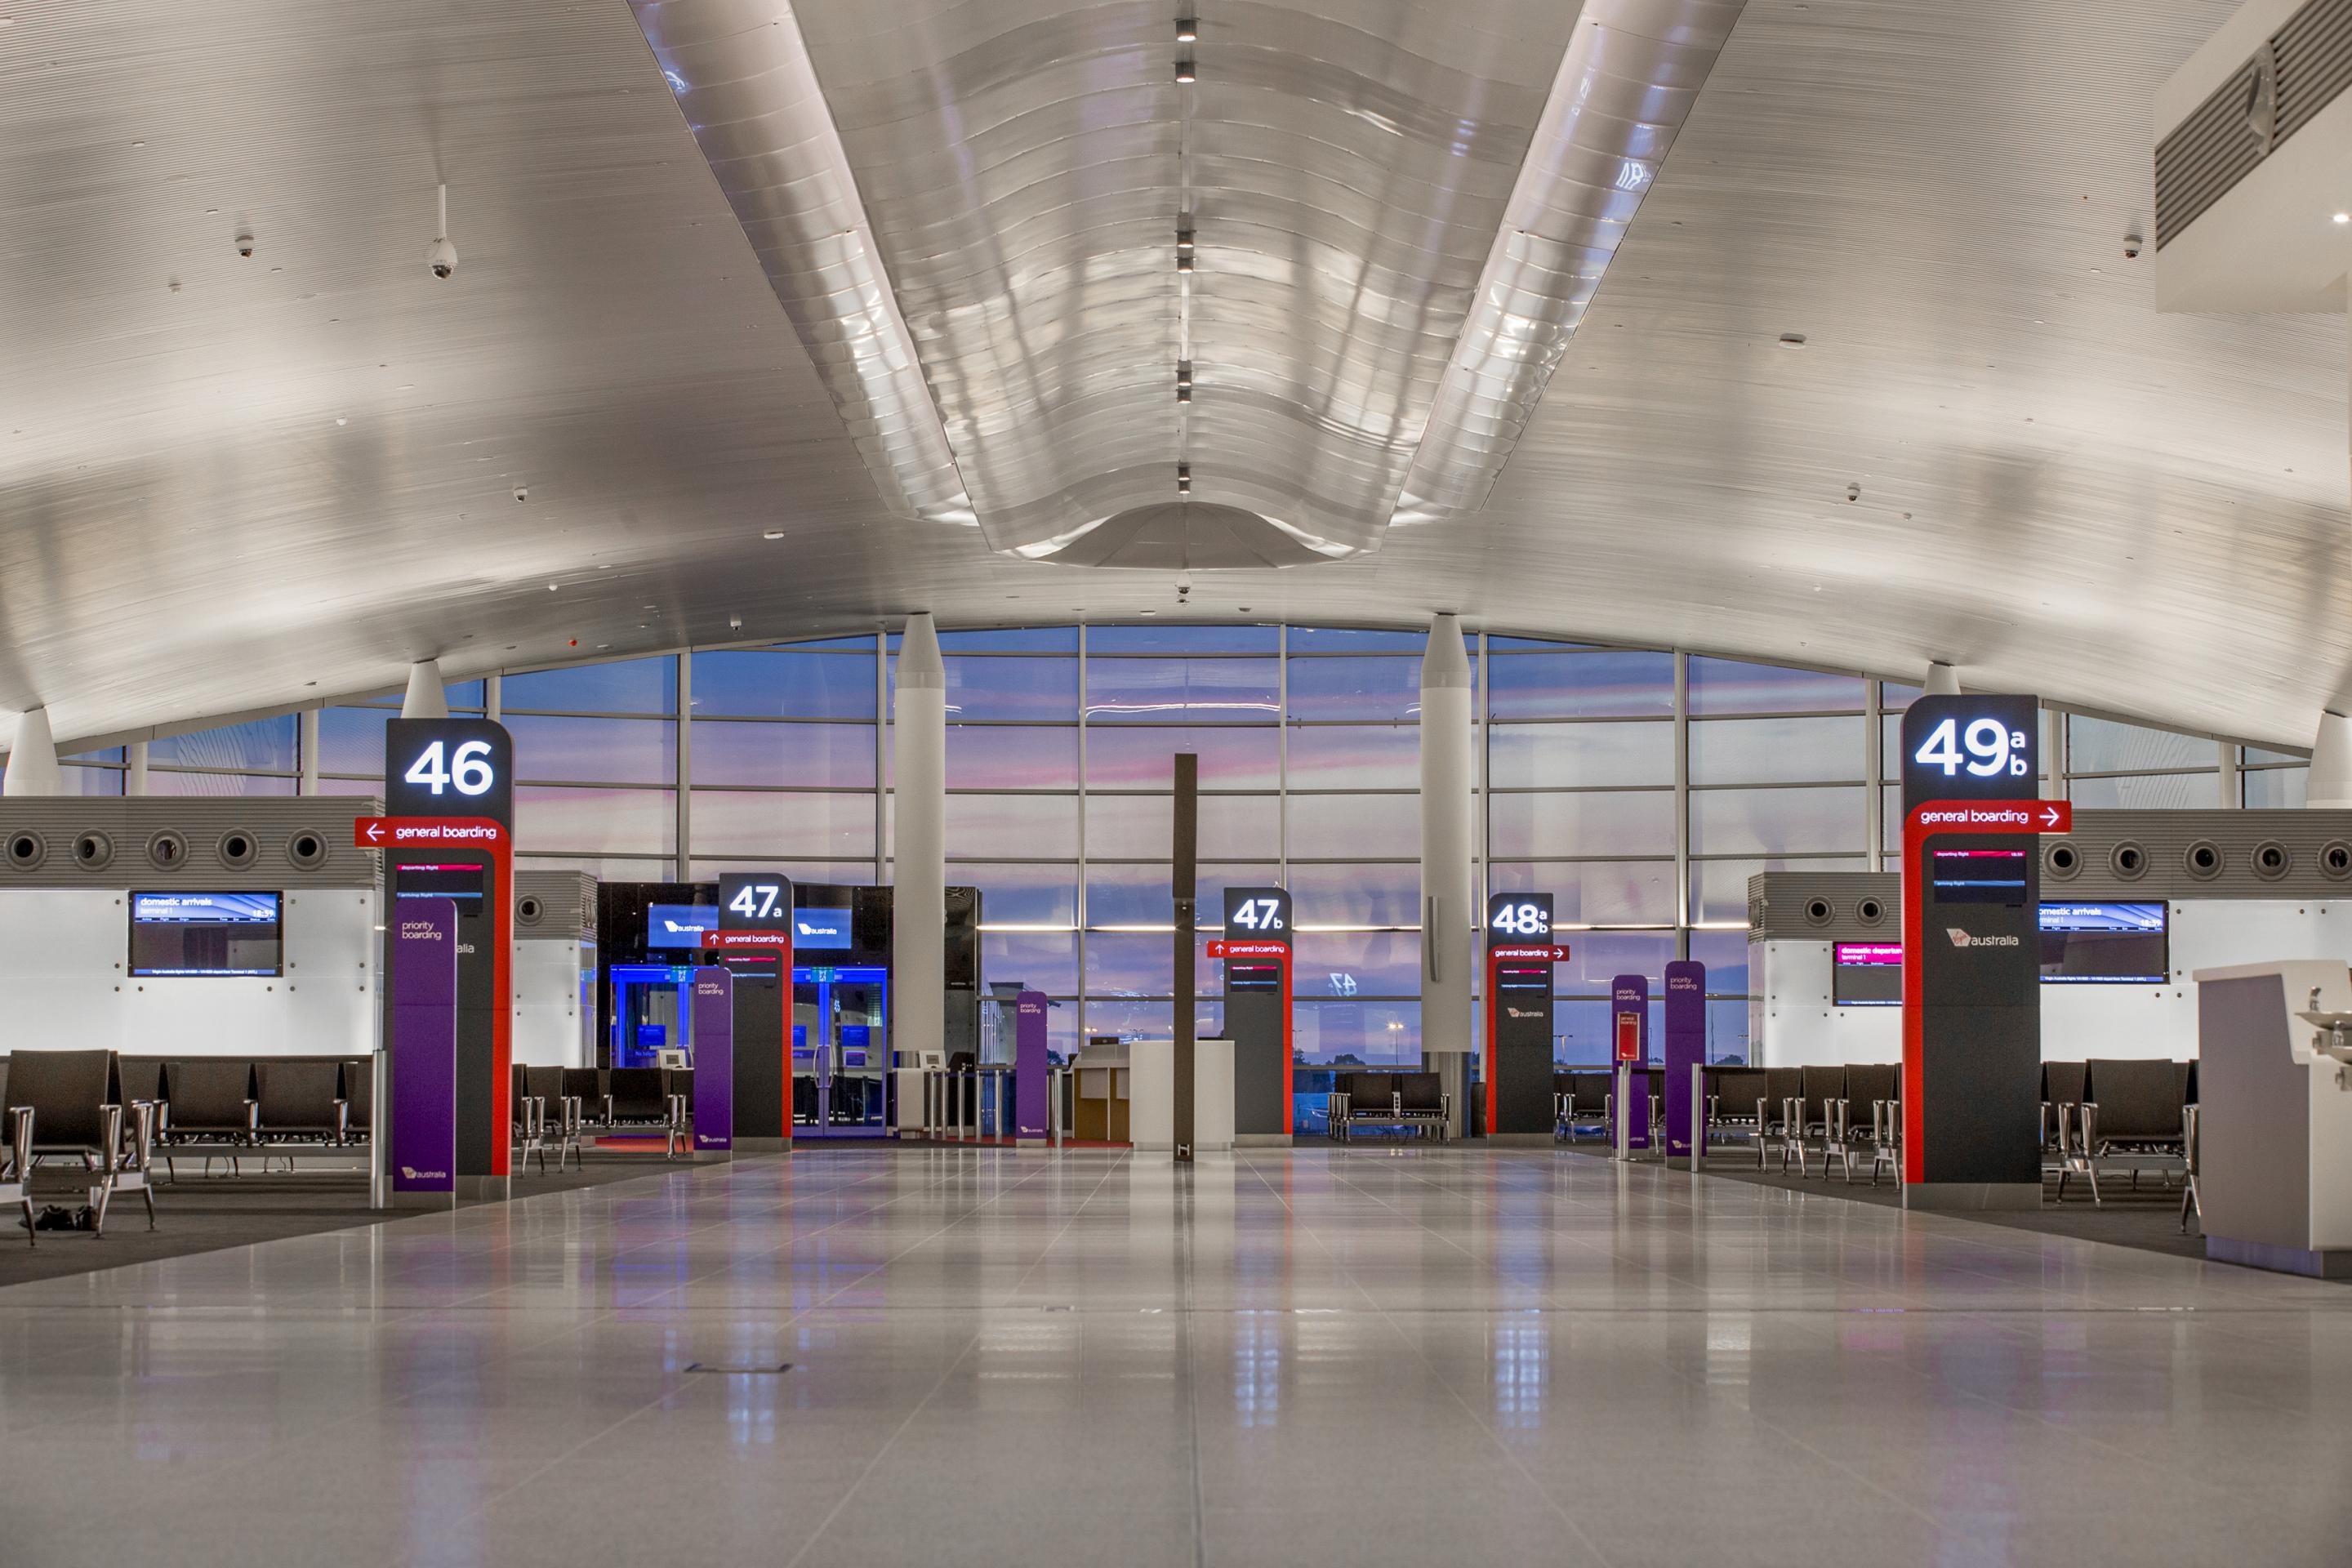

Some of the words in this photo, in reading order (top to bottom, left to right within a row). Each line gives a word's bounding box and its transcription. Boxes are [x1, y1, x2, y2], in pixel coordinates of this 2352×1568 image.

[404, 741, 493, 795] 46
[1921, 810, 1967, 824] general
[1971, 810, 2029, 824] boarding
[396, 826, 440, 838] general
[443, 826, 497, 838] boarding
[140, 898, 180, 906] domestic
[181, 898, 212, 906] arrivals
[2039, 907, 2071, 915] omestic
[2072, 907, 2102, 915] arrivals
[402, 921, 434, 931] priority
[402, 931, 442, 941] boarding
[725, 935, 751, 943] general
[753, 935, 784, 943] boarding
[1971, 936, 2019, 946] australia
[1495, 949, 1519, 957] general
[1520, 949, 1548, 957] boarding
[1670, 977, 1691, 985] priority
[416, 1170, 447, 1178] australia
